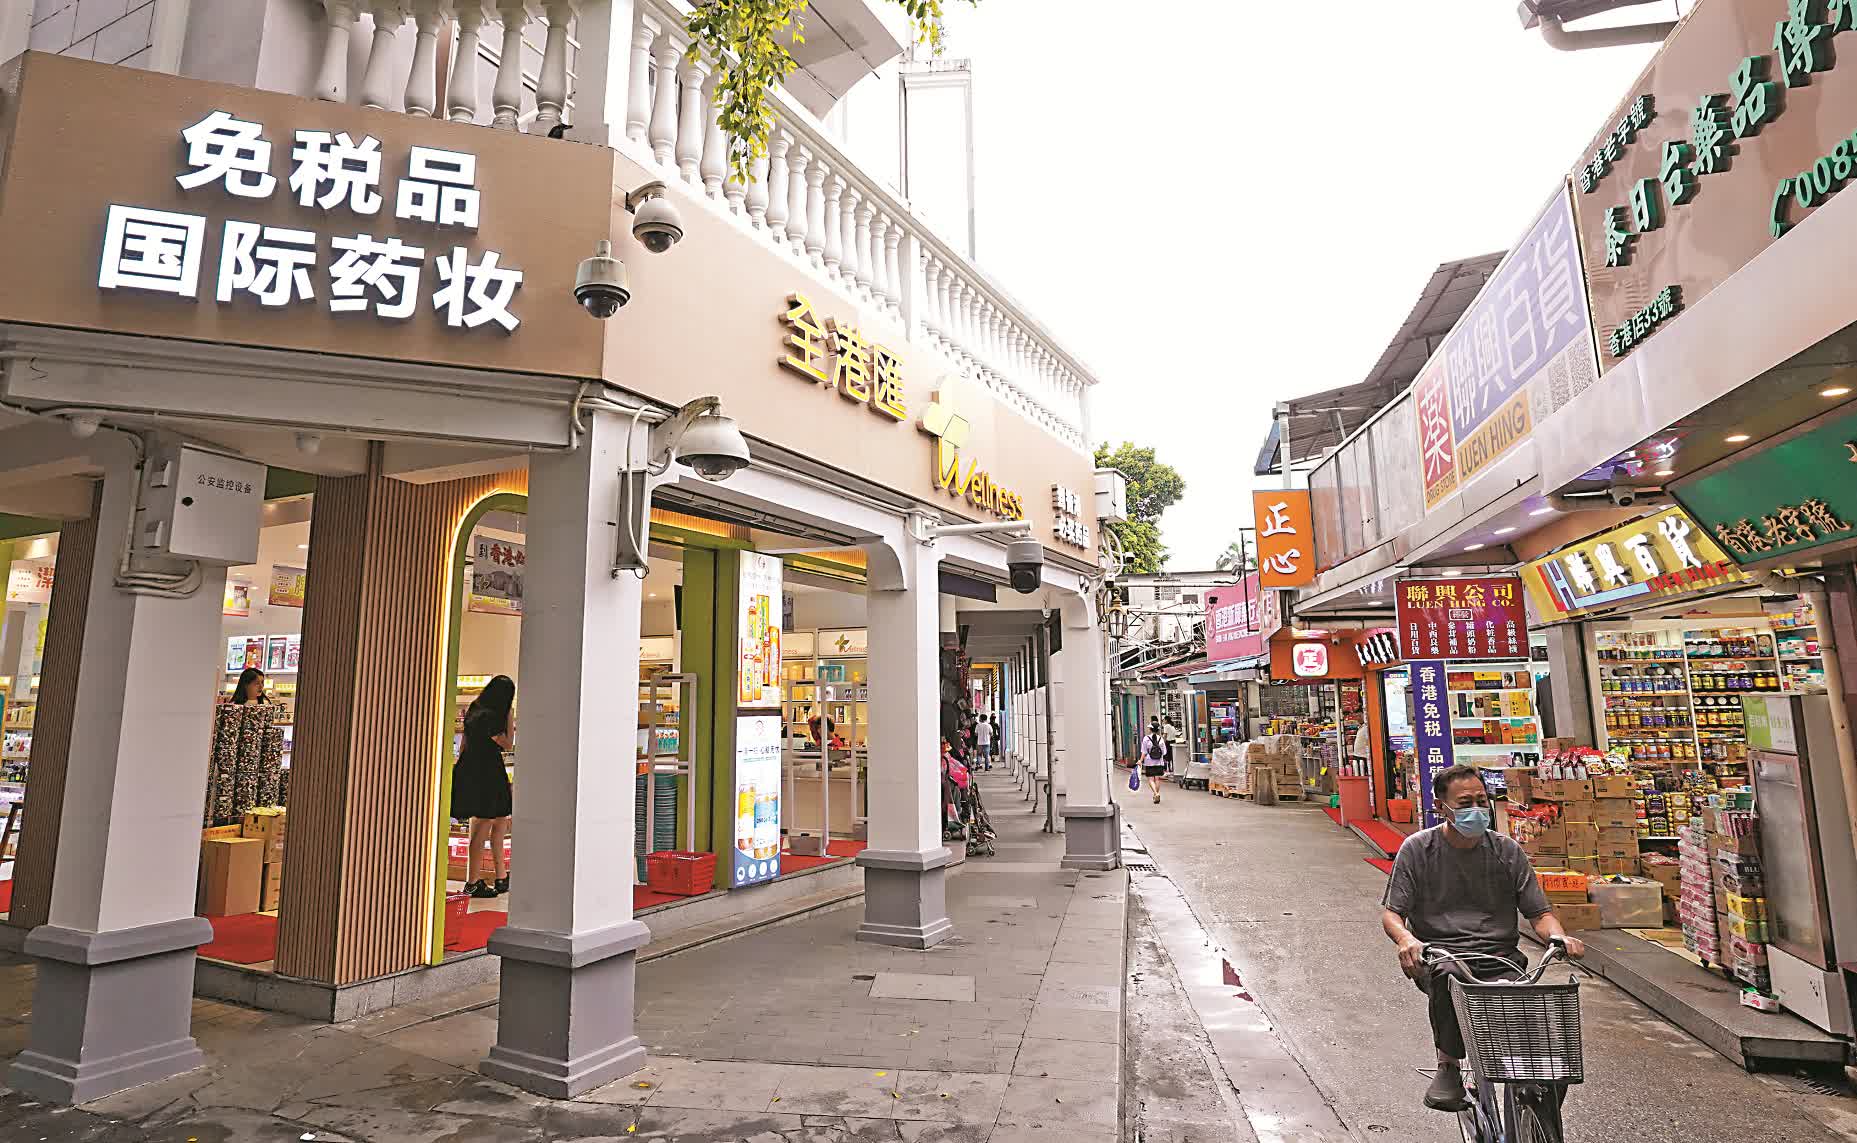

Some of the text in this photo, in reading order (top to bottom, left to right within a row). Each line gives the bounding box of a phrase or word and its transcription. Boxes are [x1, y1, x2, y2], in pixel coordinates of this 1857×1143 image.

[176, 109, 482, 230] 免税品
[1579, 94, 1650, 195] 香港老字號
[98, 203, 525, 332] 国际药妆
[784, 292, 907, 421] 全港匯
[1449, 212, 1580, 430] 聯興百貨
[1608, 286, 1676, 357] 香港店33號
[1419, 377, 1452, 482] 藥
[1459, 432, 1488, 477] LUEN
[1489, 401, 1526, 455] HING
[197, 474, 253, 494] 公安监控设备
[938, 440, 1025, 522] Wellness
[1261, 501, 1301, 575] 正心
[1406, 583, 1514, 602] 聯興公司
[1407, 599, 1515, 609] LUEN HING CO.
[1409, 622, 1420, 655] 日用百貨
[1465, 621, 1477, 654] 罐頭奶粉
[1419, 666, 1443, 737] 香港免税
